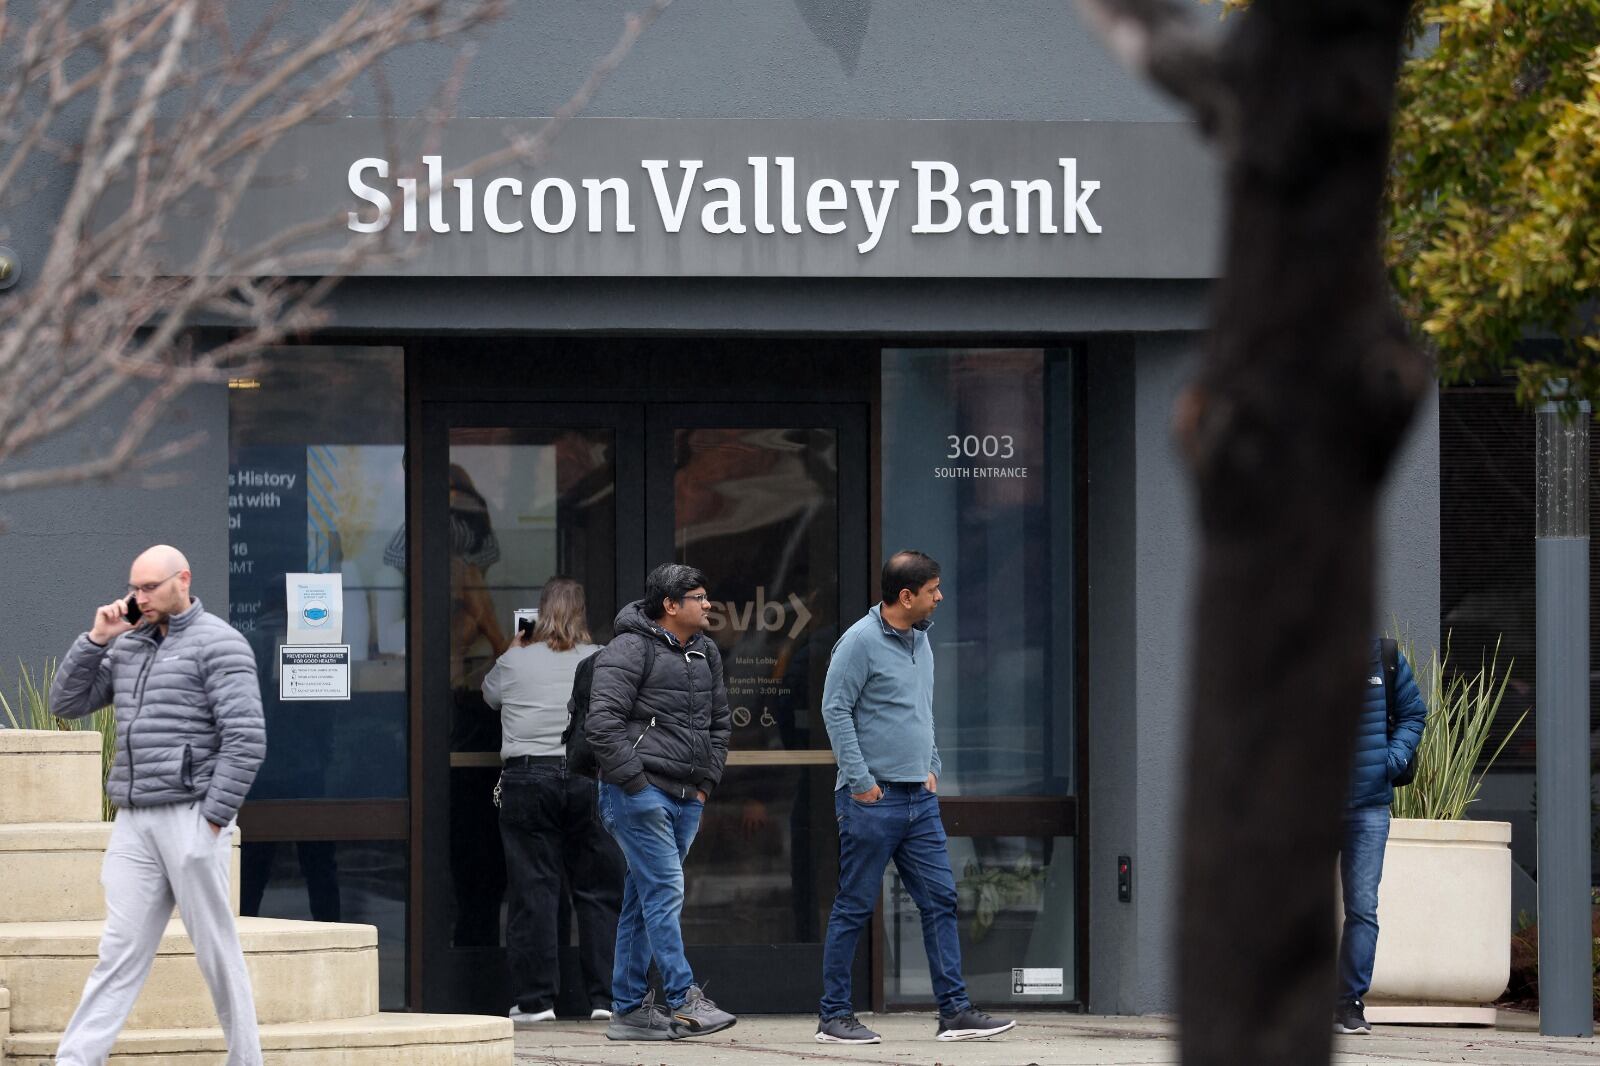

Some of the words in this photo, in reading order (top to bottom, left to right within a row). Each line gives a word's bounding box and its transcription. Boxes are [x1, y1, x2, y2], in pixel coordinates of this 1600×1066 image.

[347, 155, 635, 234] Silicon
[641, 156, 900, 254] Valley
[911, 157, 1103, 235] Bank
[947, 435, 1014, 459] 3003
[934, 467, 970, 478] SOUTH
[973, 467, 1028, 478] ENTRANCE
[238, 471, 297, 489] History
[246, 492, 281, 507] with
[735, 656, 754, 665] Main
[756, 656, 778, 667] Lobby
[729, 676, 756, 684] Branch
[741, 687, 754, 695] am
[778, 687, 791, 696] pm
